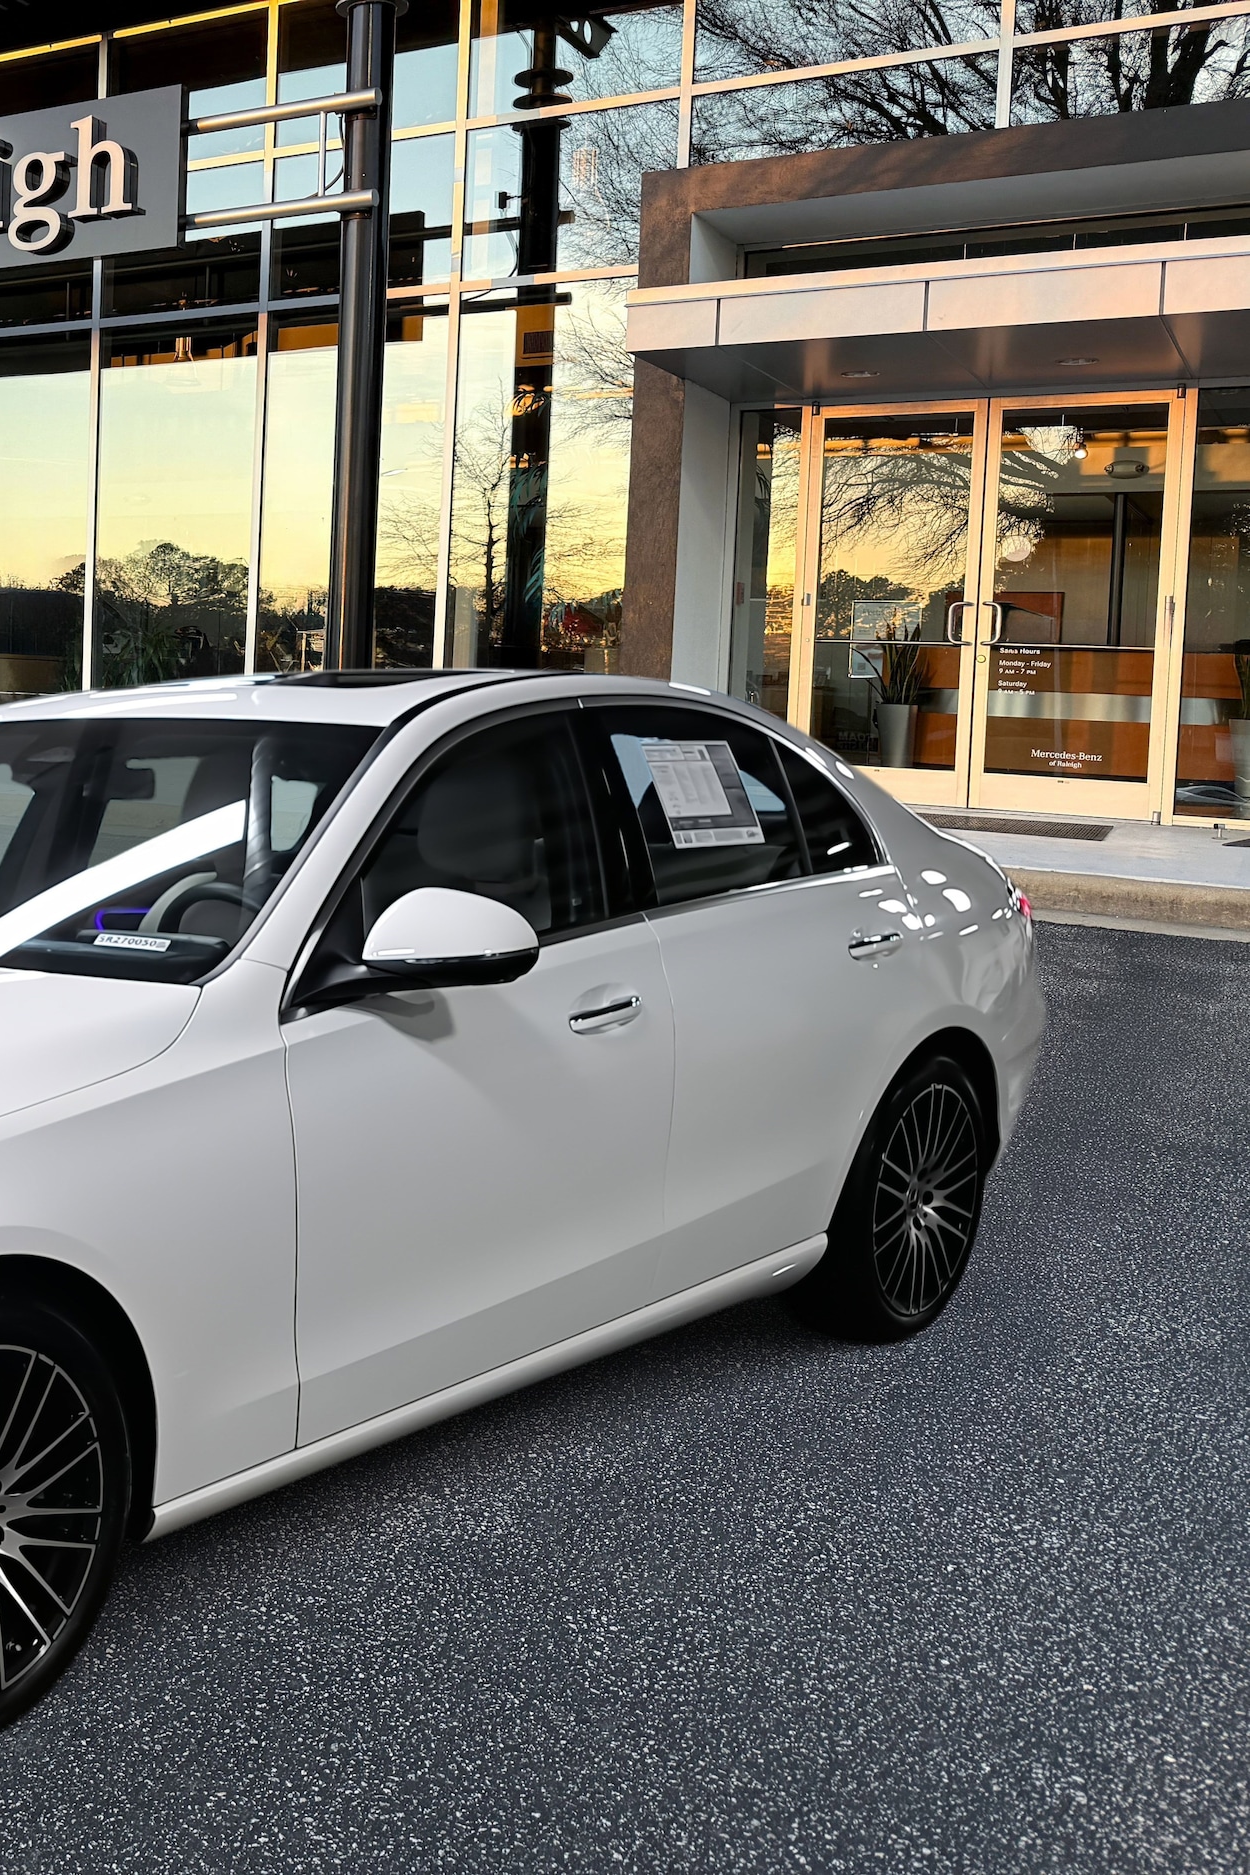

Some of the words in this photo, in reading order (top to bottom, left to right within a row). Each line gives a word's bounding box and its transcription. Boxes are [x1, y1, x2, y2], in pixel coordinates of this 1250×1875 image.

[998, 680, 1028, 688] Saturday
[1030, 748, 1102, 762] Mercedes-Benz
[1056, 760, 1082, 769] Raleigh
